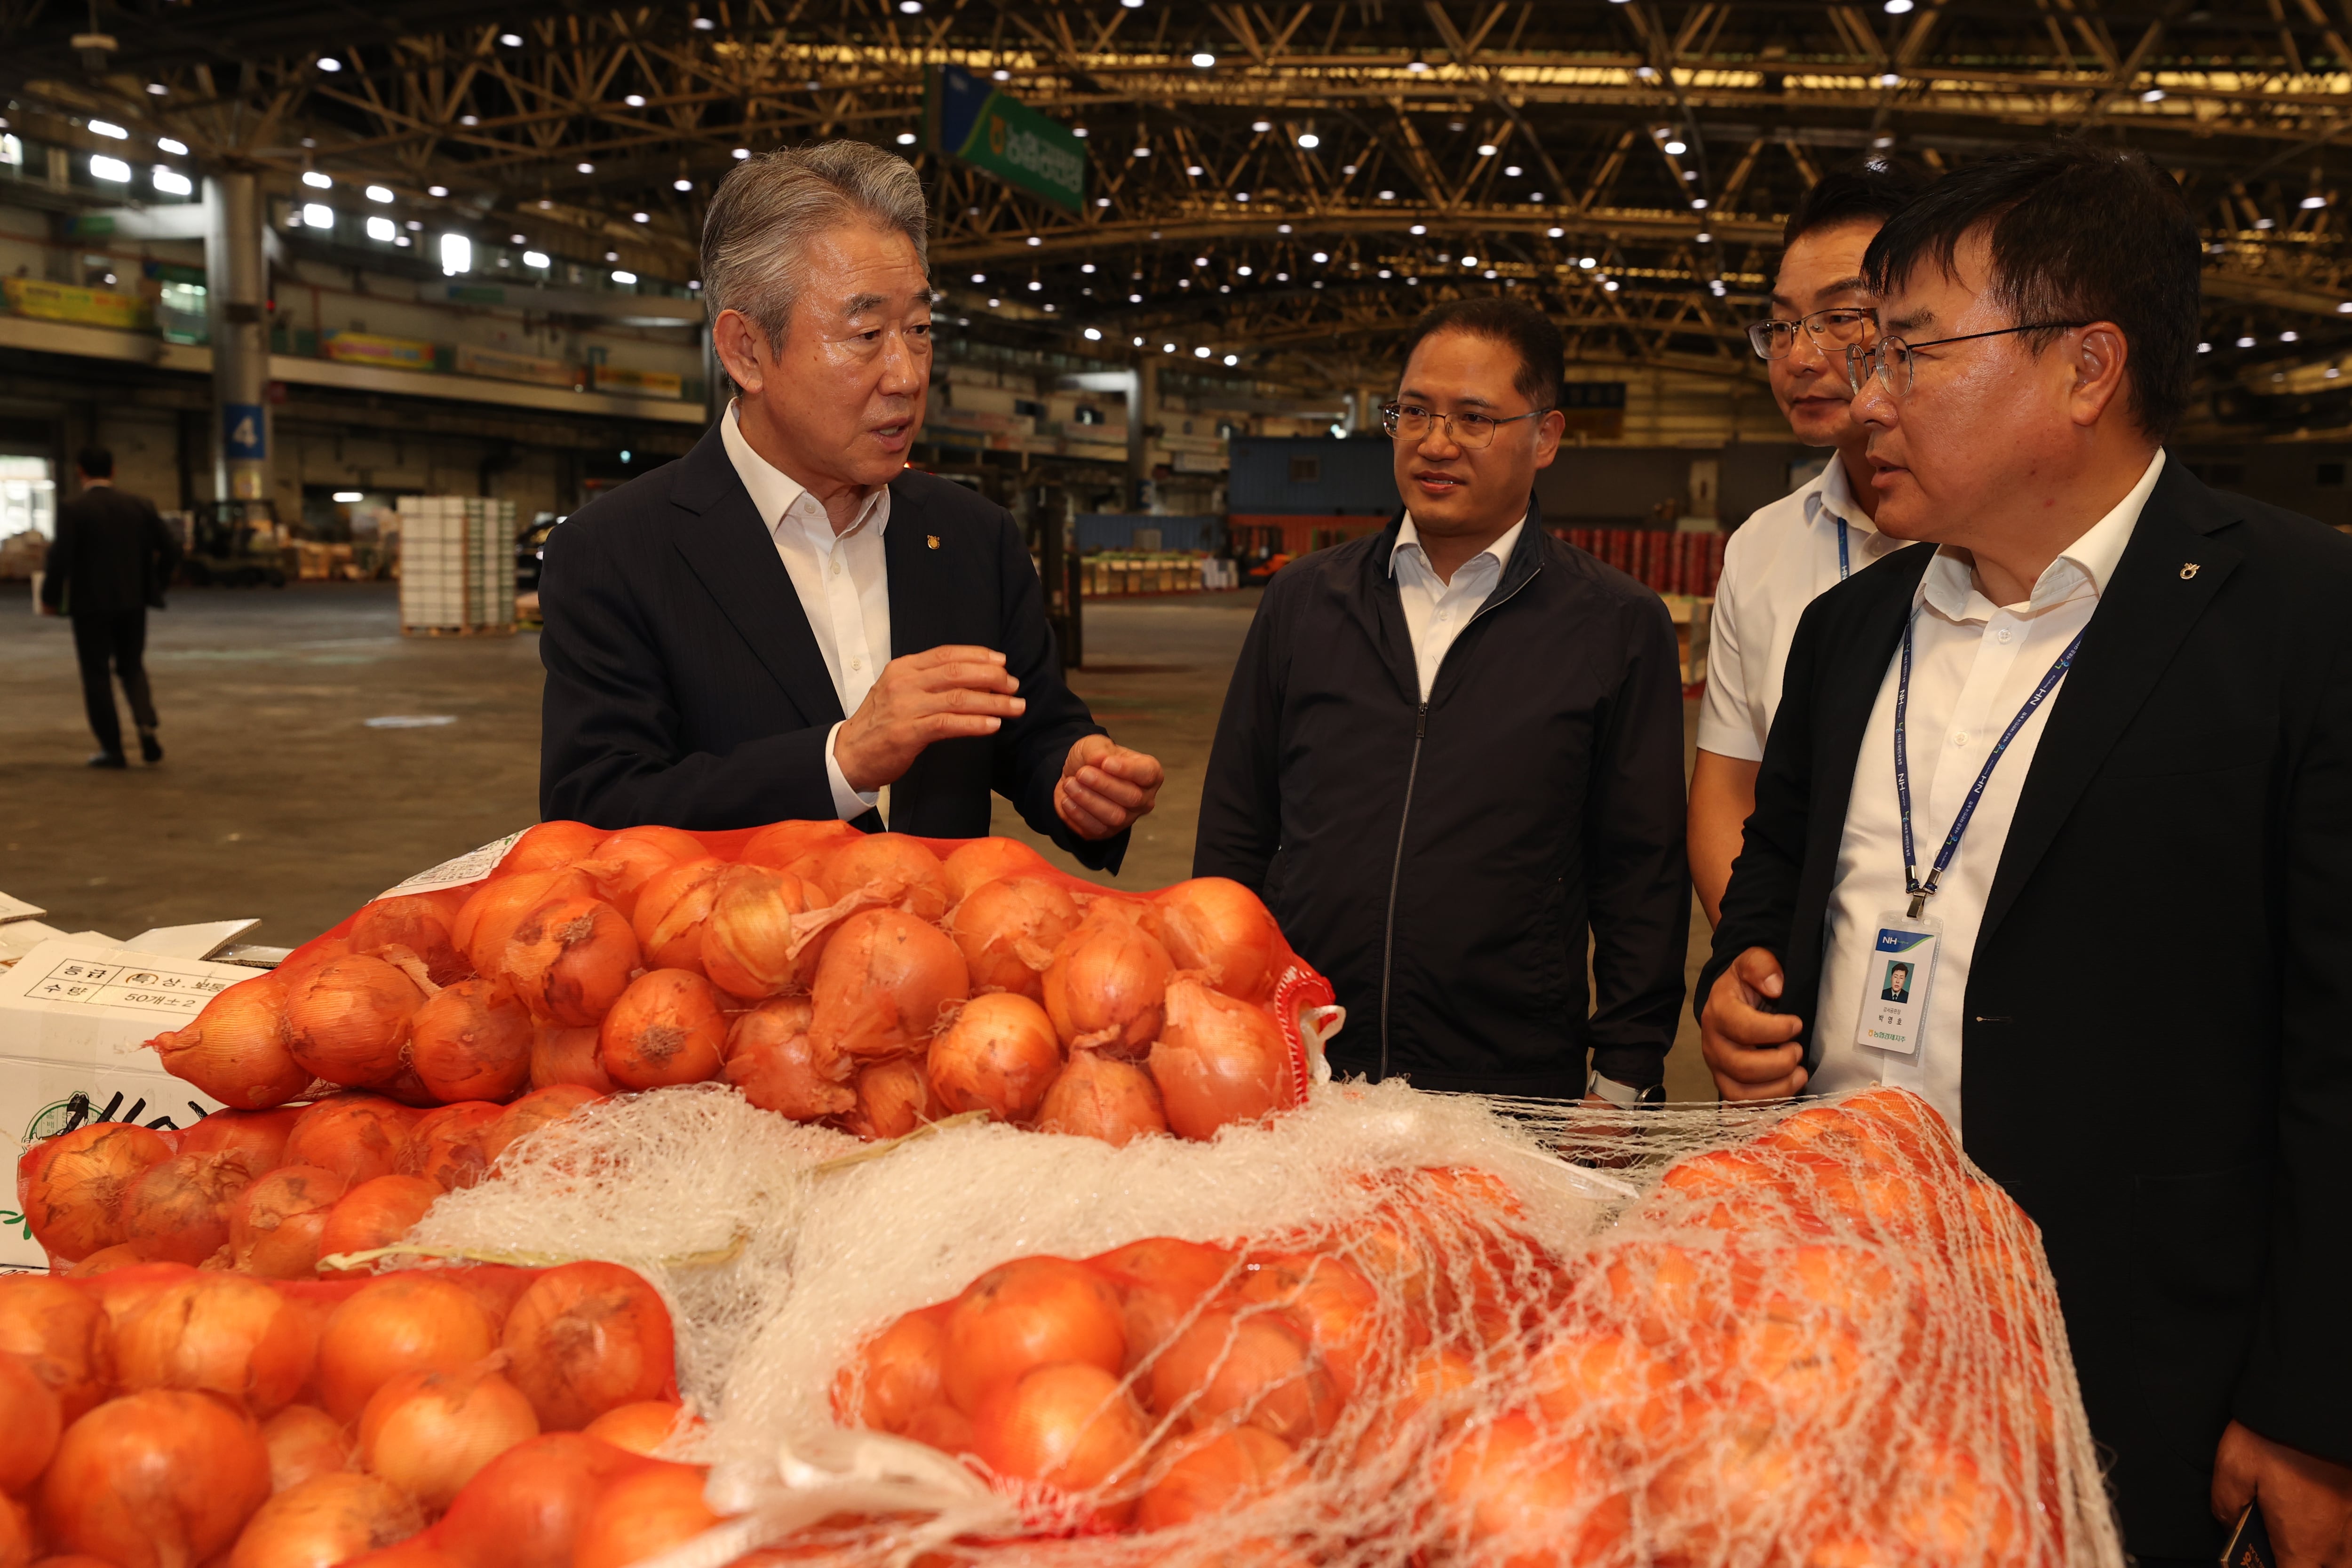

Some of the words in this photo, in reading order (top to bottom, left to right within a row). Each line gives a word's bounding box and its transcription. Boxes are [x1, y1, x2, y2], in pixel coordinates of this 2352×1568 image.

[234, 416, 257, 447] 4
[1898, 689, 1905, 705] NH
[2029, 688, 2046, 706] NH
[1898, 773, 1906, 790] NH
[1974, 775, 1986, 794] NH
[1882, 936, 1898, 945] NH
